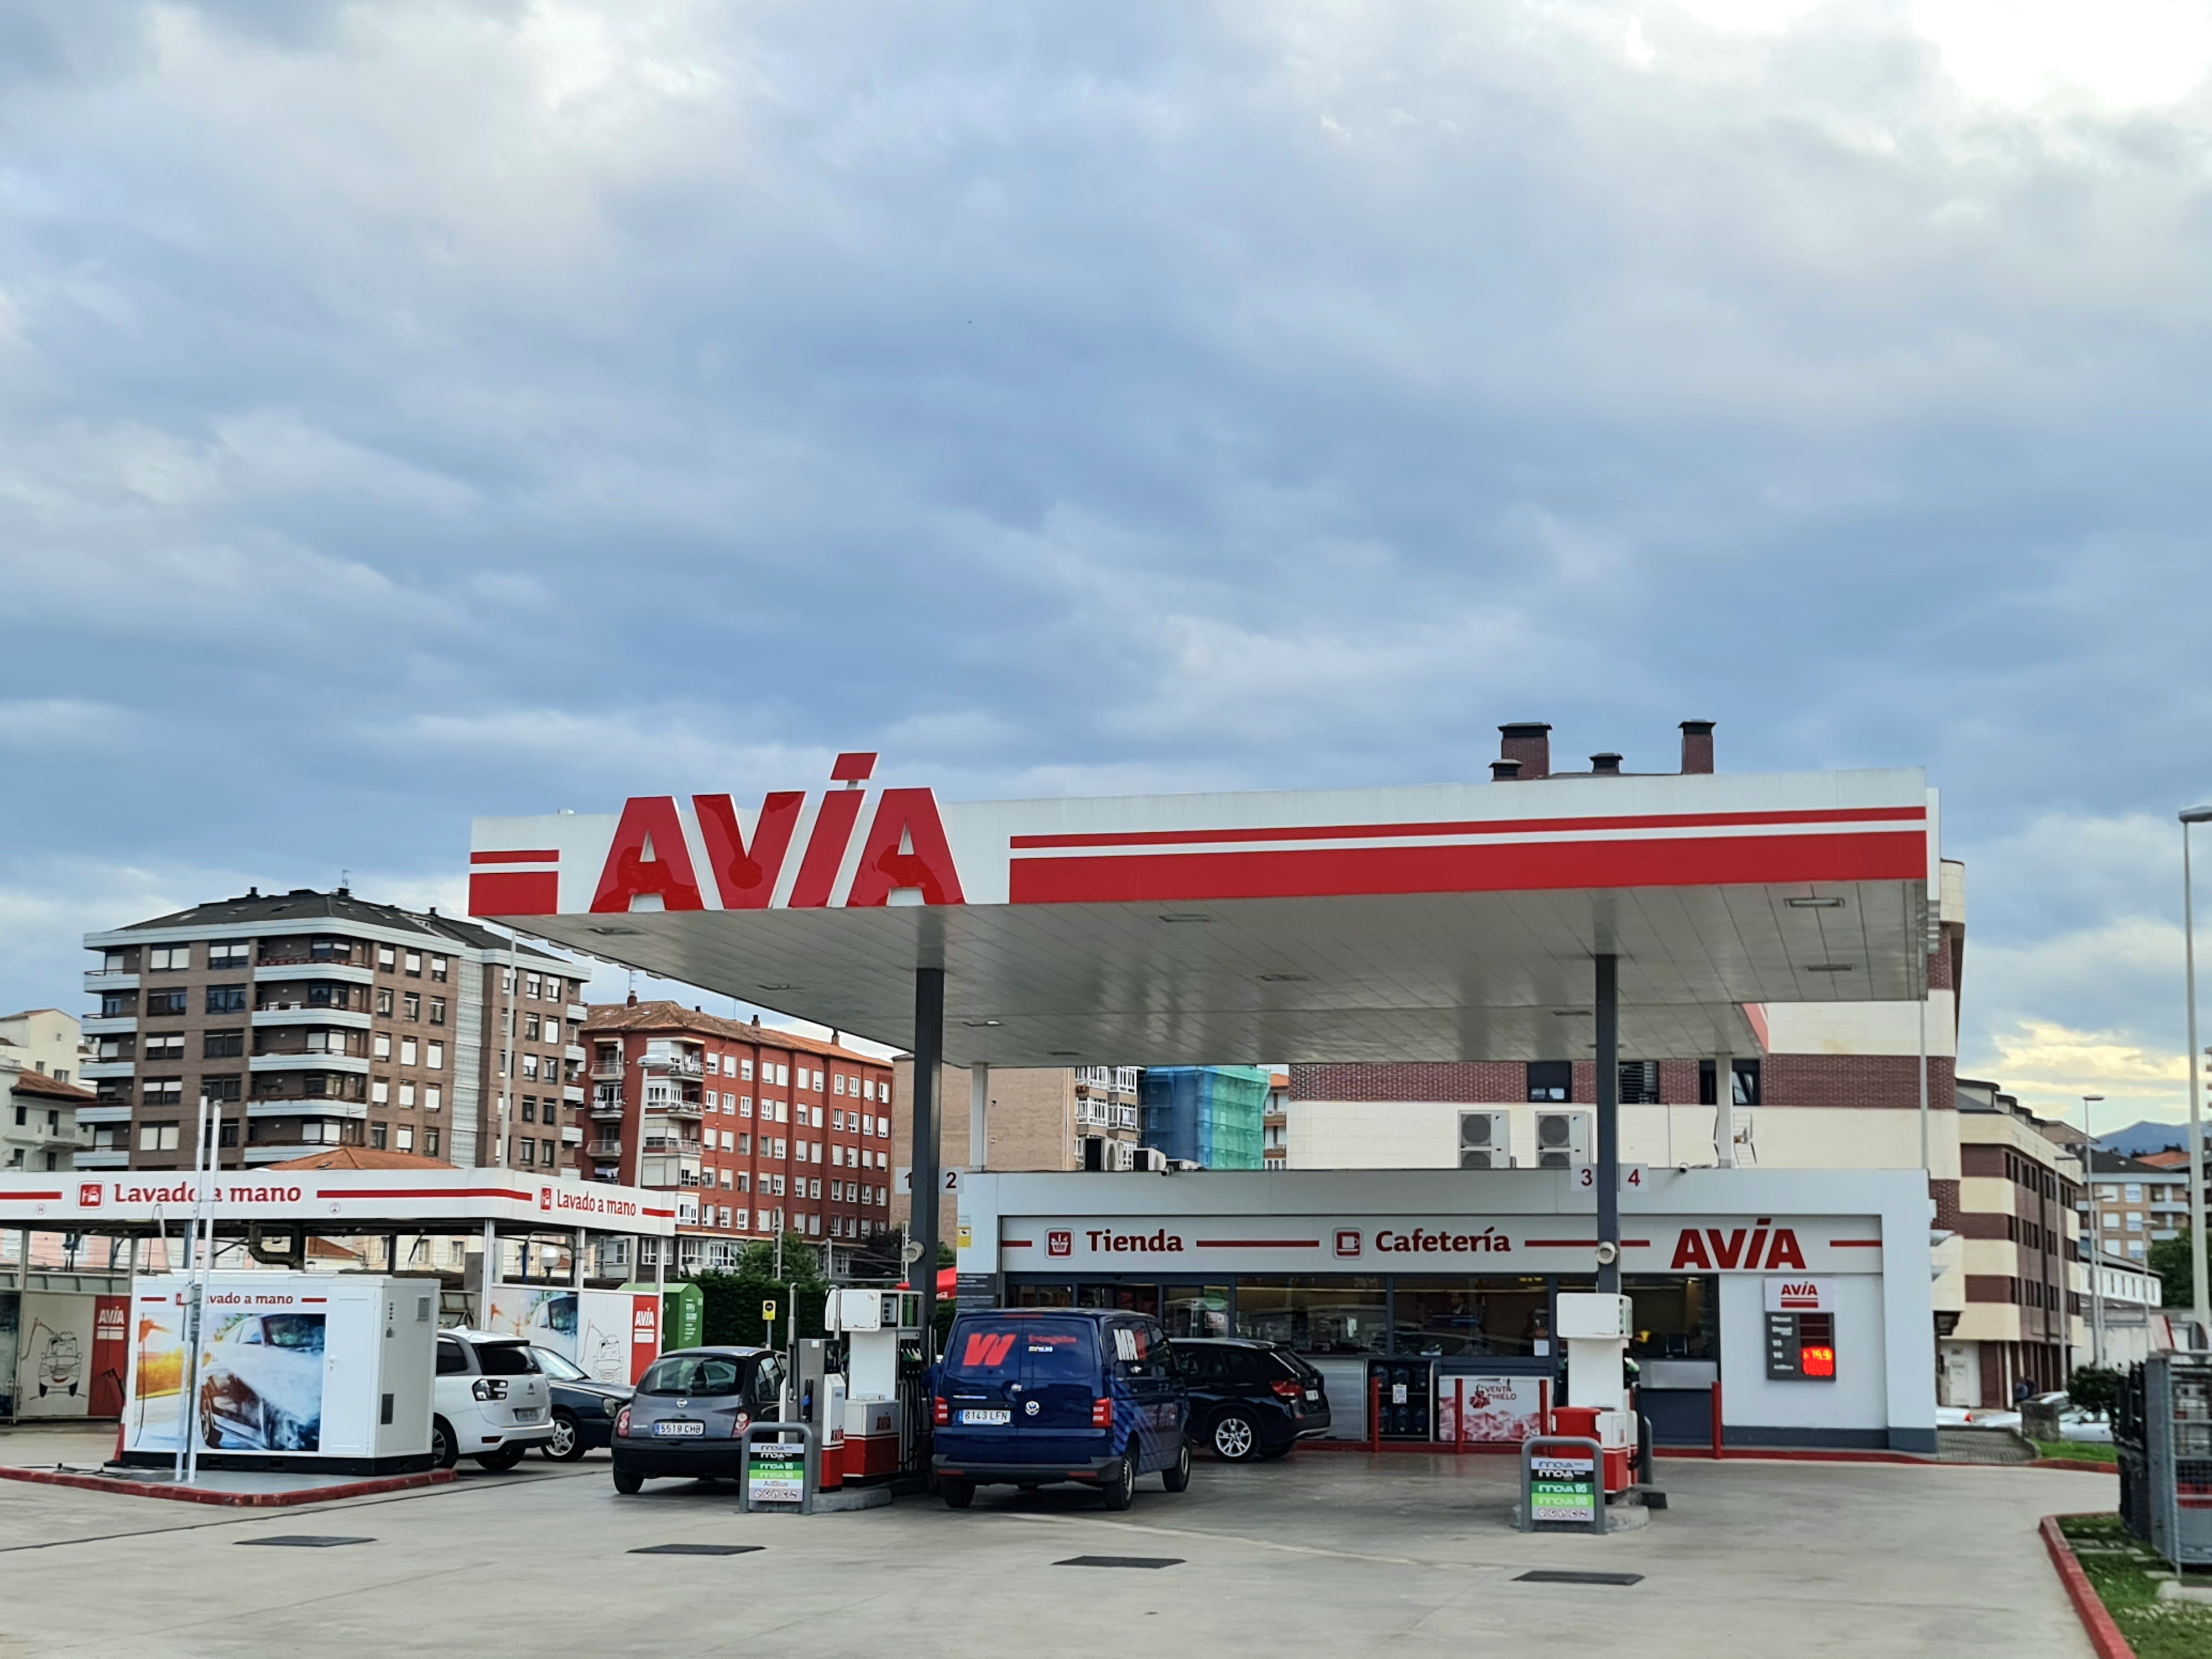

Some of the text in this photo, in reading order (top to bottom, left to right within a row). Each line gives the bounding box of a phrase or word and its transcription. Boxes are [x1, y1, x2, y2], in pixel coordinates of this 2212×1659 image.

[946, 1172, 957, 1189] 2
[1581, 1168, 1593, 1187] 3
[1627, 1168, 1641, 1187] 4
[114, 1181, 196, 1202] Lavado
[229, 1186, 301, 1202] mano
[557, 1190, 637, 1217] Lavado a mano
[1086, 1228, 1184, 1252] Tienda
[1375, 1226, 1511, 1252] Cafetería
[206, 1291, 294, 1305] vado a mano
